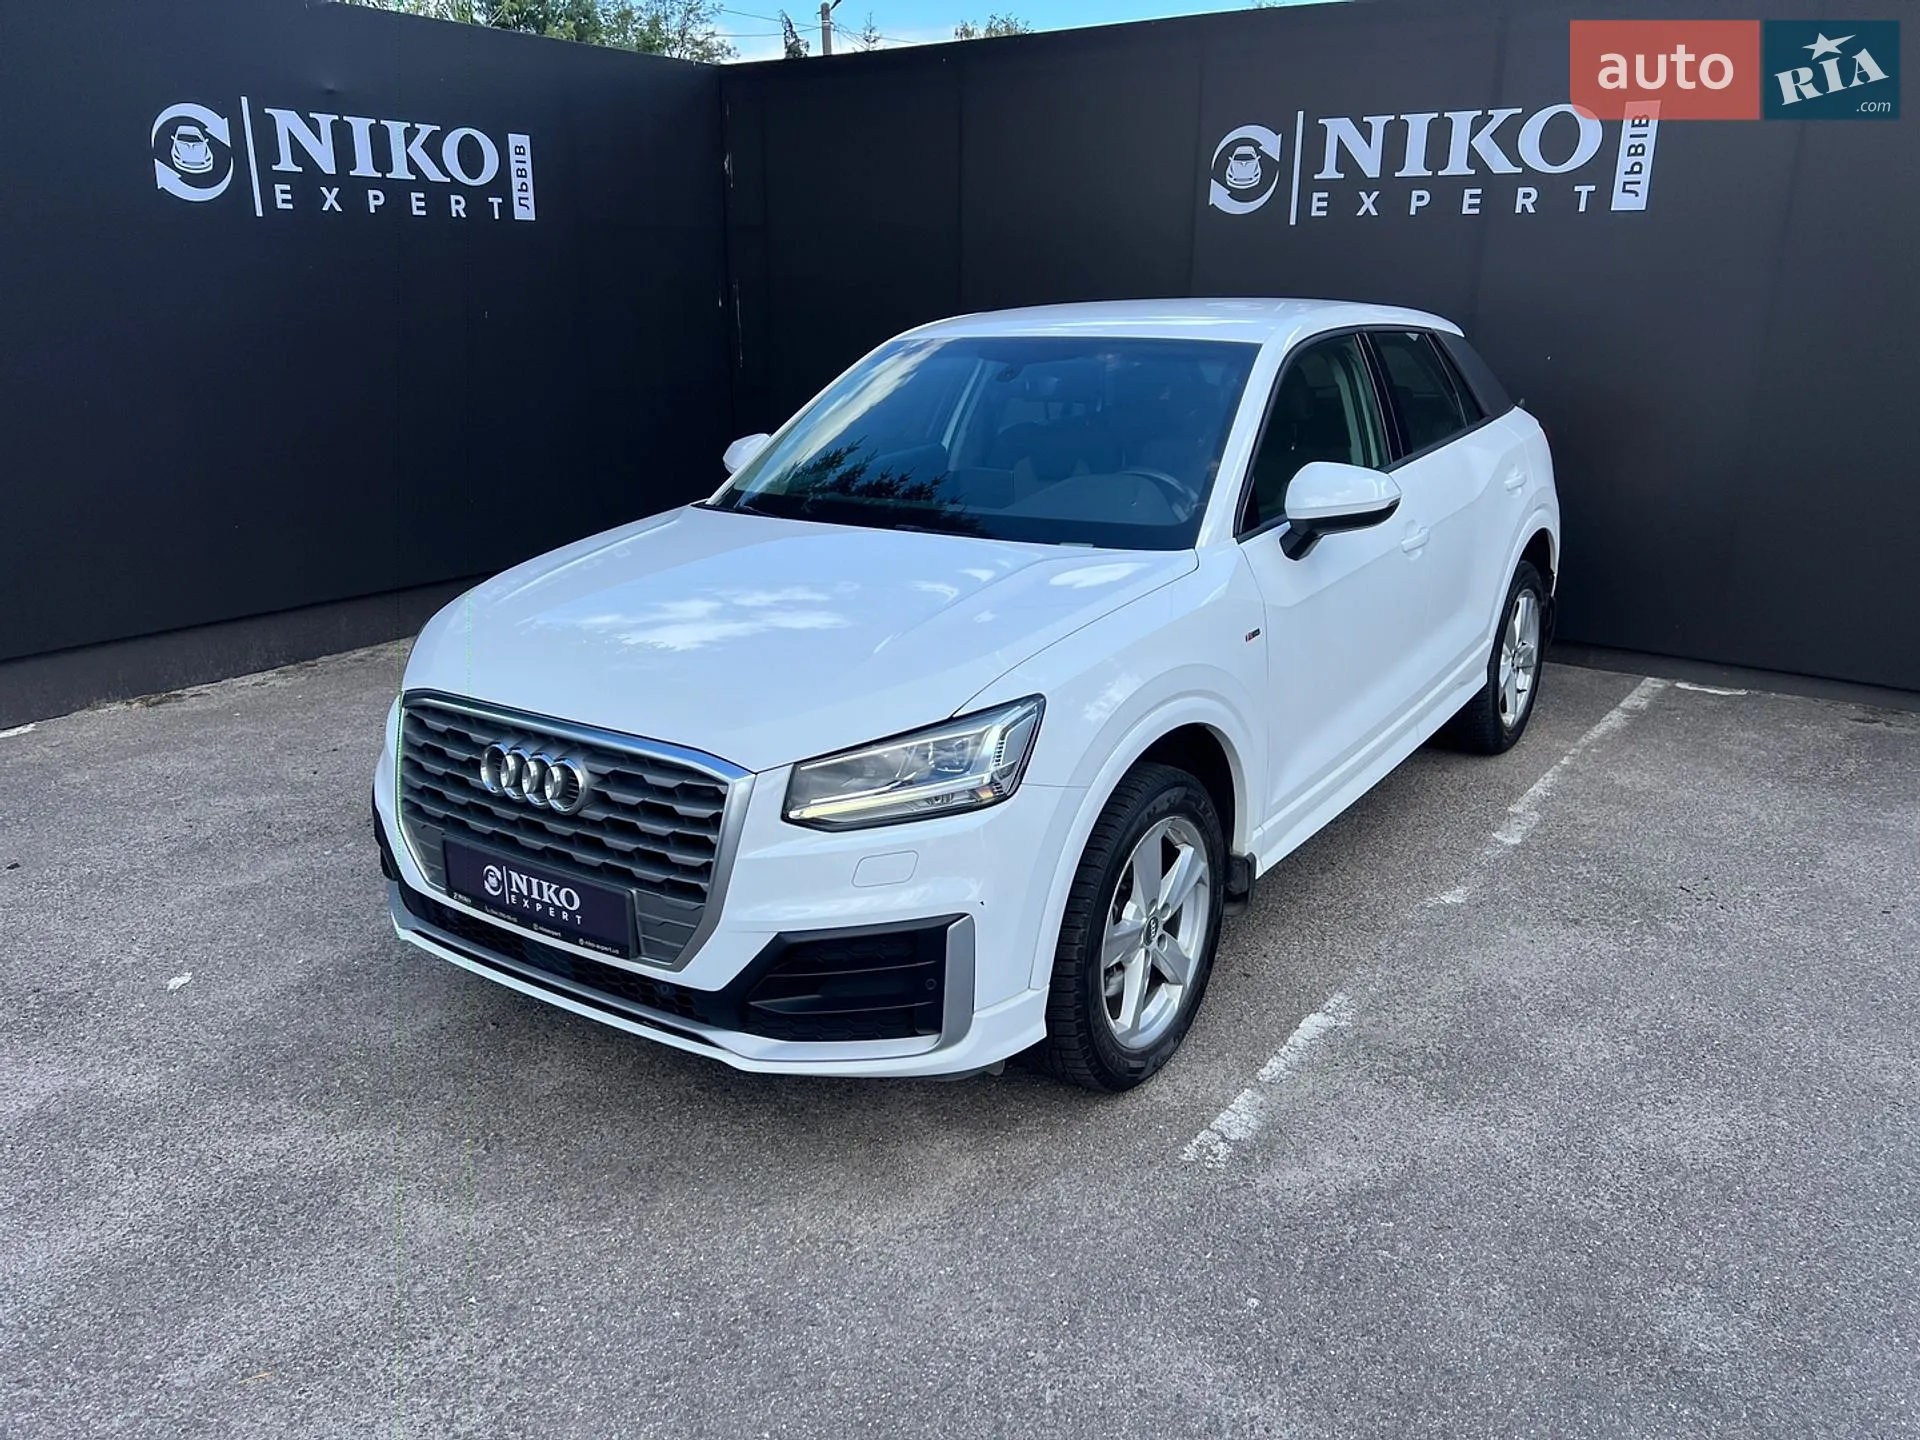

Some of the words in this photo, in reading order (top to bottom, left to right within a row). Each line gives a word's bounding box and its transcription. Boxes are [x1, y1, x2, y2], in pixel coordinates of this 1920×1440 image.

[264, 107, 500, 187] NIKO
[1313, 103, 1603, 179] NIKO
[274, 183, 503, 220] EXPERT
[1310, 185, 1596, 217] EXPERT
[508, 870, 580, 911] NIKO
[511, 894, 582, 925] EXPERT
